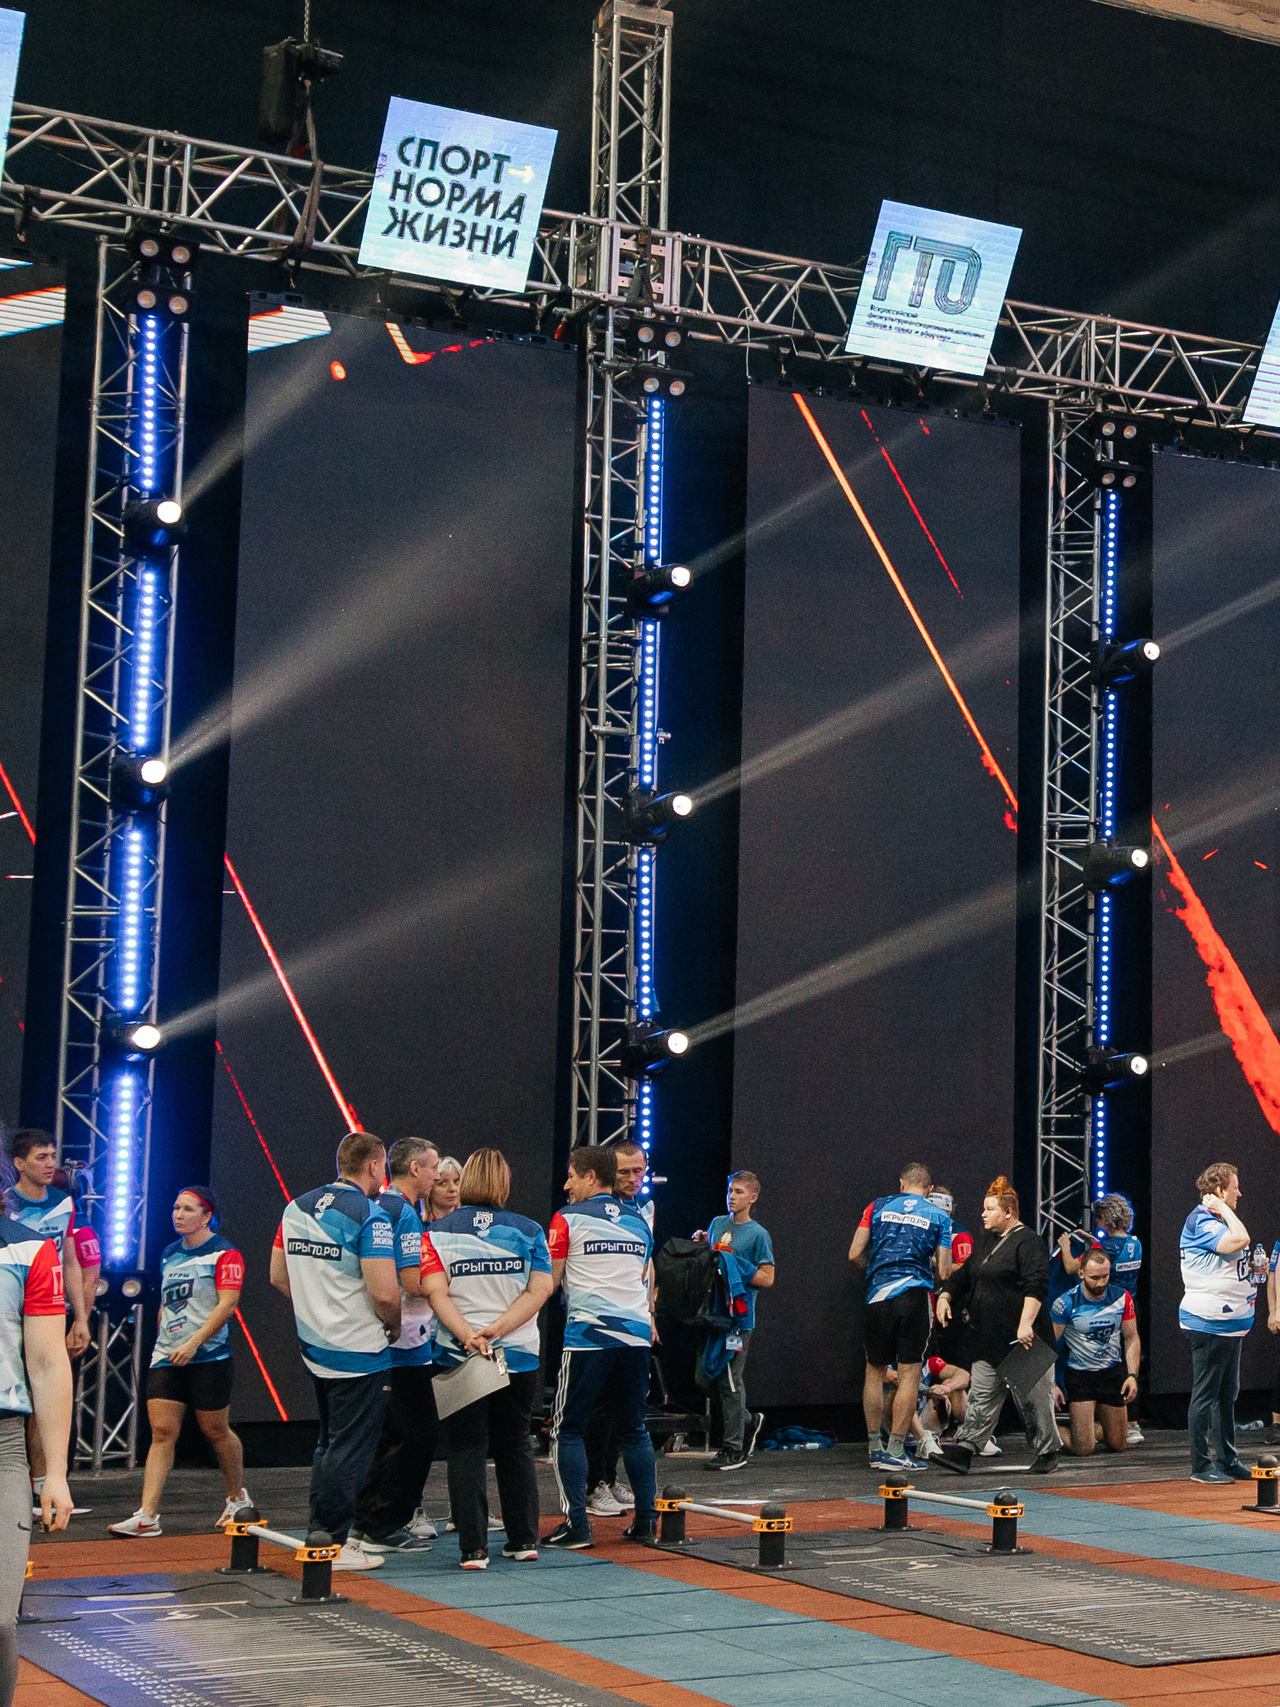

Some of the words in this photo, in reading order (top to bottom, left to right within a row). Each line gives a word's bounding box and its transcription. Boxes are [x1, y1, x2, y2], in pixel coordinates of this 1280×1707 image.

[396, 134, 511, 184] СПОРТ
[388, 169, 527, 225] НОРМА
[381, 206, 520, 259] ЖИЗНИ
[872, 230, 982, 315] ГТО
